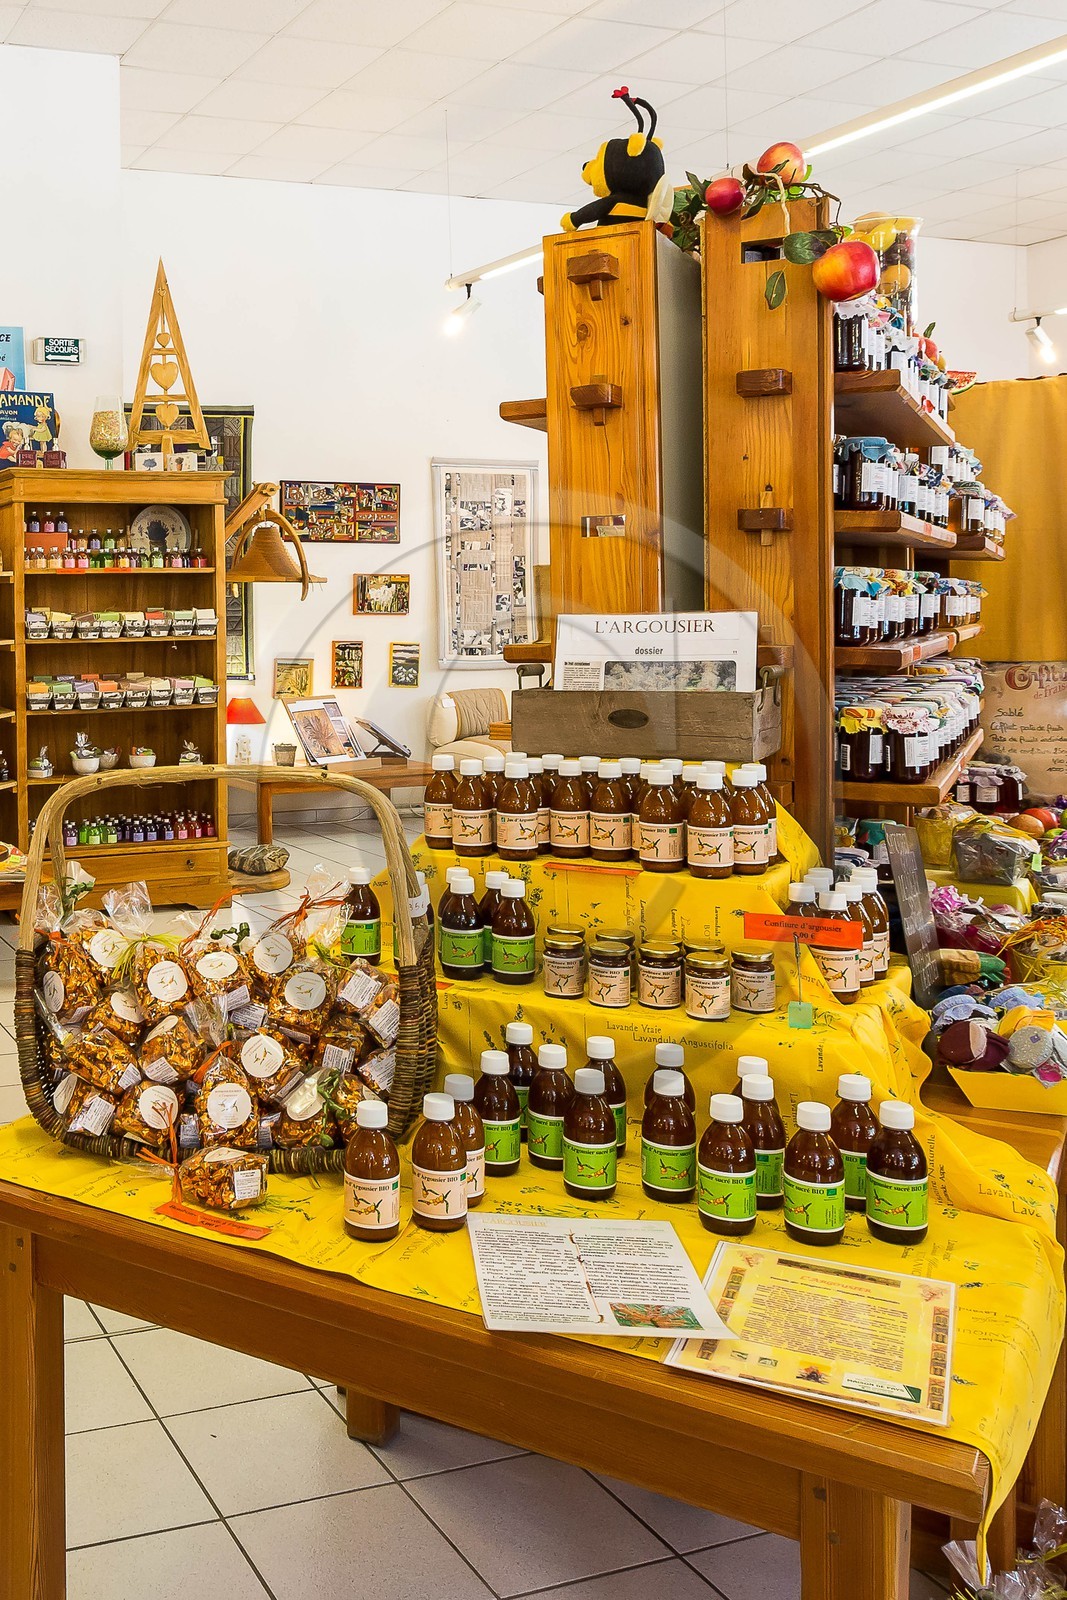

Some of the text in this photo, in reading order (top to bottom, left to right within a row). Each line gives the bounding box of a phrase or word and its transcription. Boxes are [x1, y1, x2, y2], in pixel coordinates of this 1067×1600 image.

[48, 338, 75, 347] SORTIE
[45, 345, 79, 354] SECOURS
[595, 619, 715, 634] L'ARGOUSIER
[635, 647, 663, 655] dossier
[994, 707, 1024, 718] Sablé
[764, 919, 842, 933] Confiture d'argousier
[606, 1021, 662, 1034] Lavande Vraie
[632, 1032, 734, 1051] Lavandula Angustifolia
[927, 1134, 936, 1178] Naturelle
[417, 1172, 446, 1182] d'Argousier
[714, 1176, 731, 1184] sucré
[349, 1181, 378, 1192] d'Argousier
[795, 1185, 810, 1193] sucré
